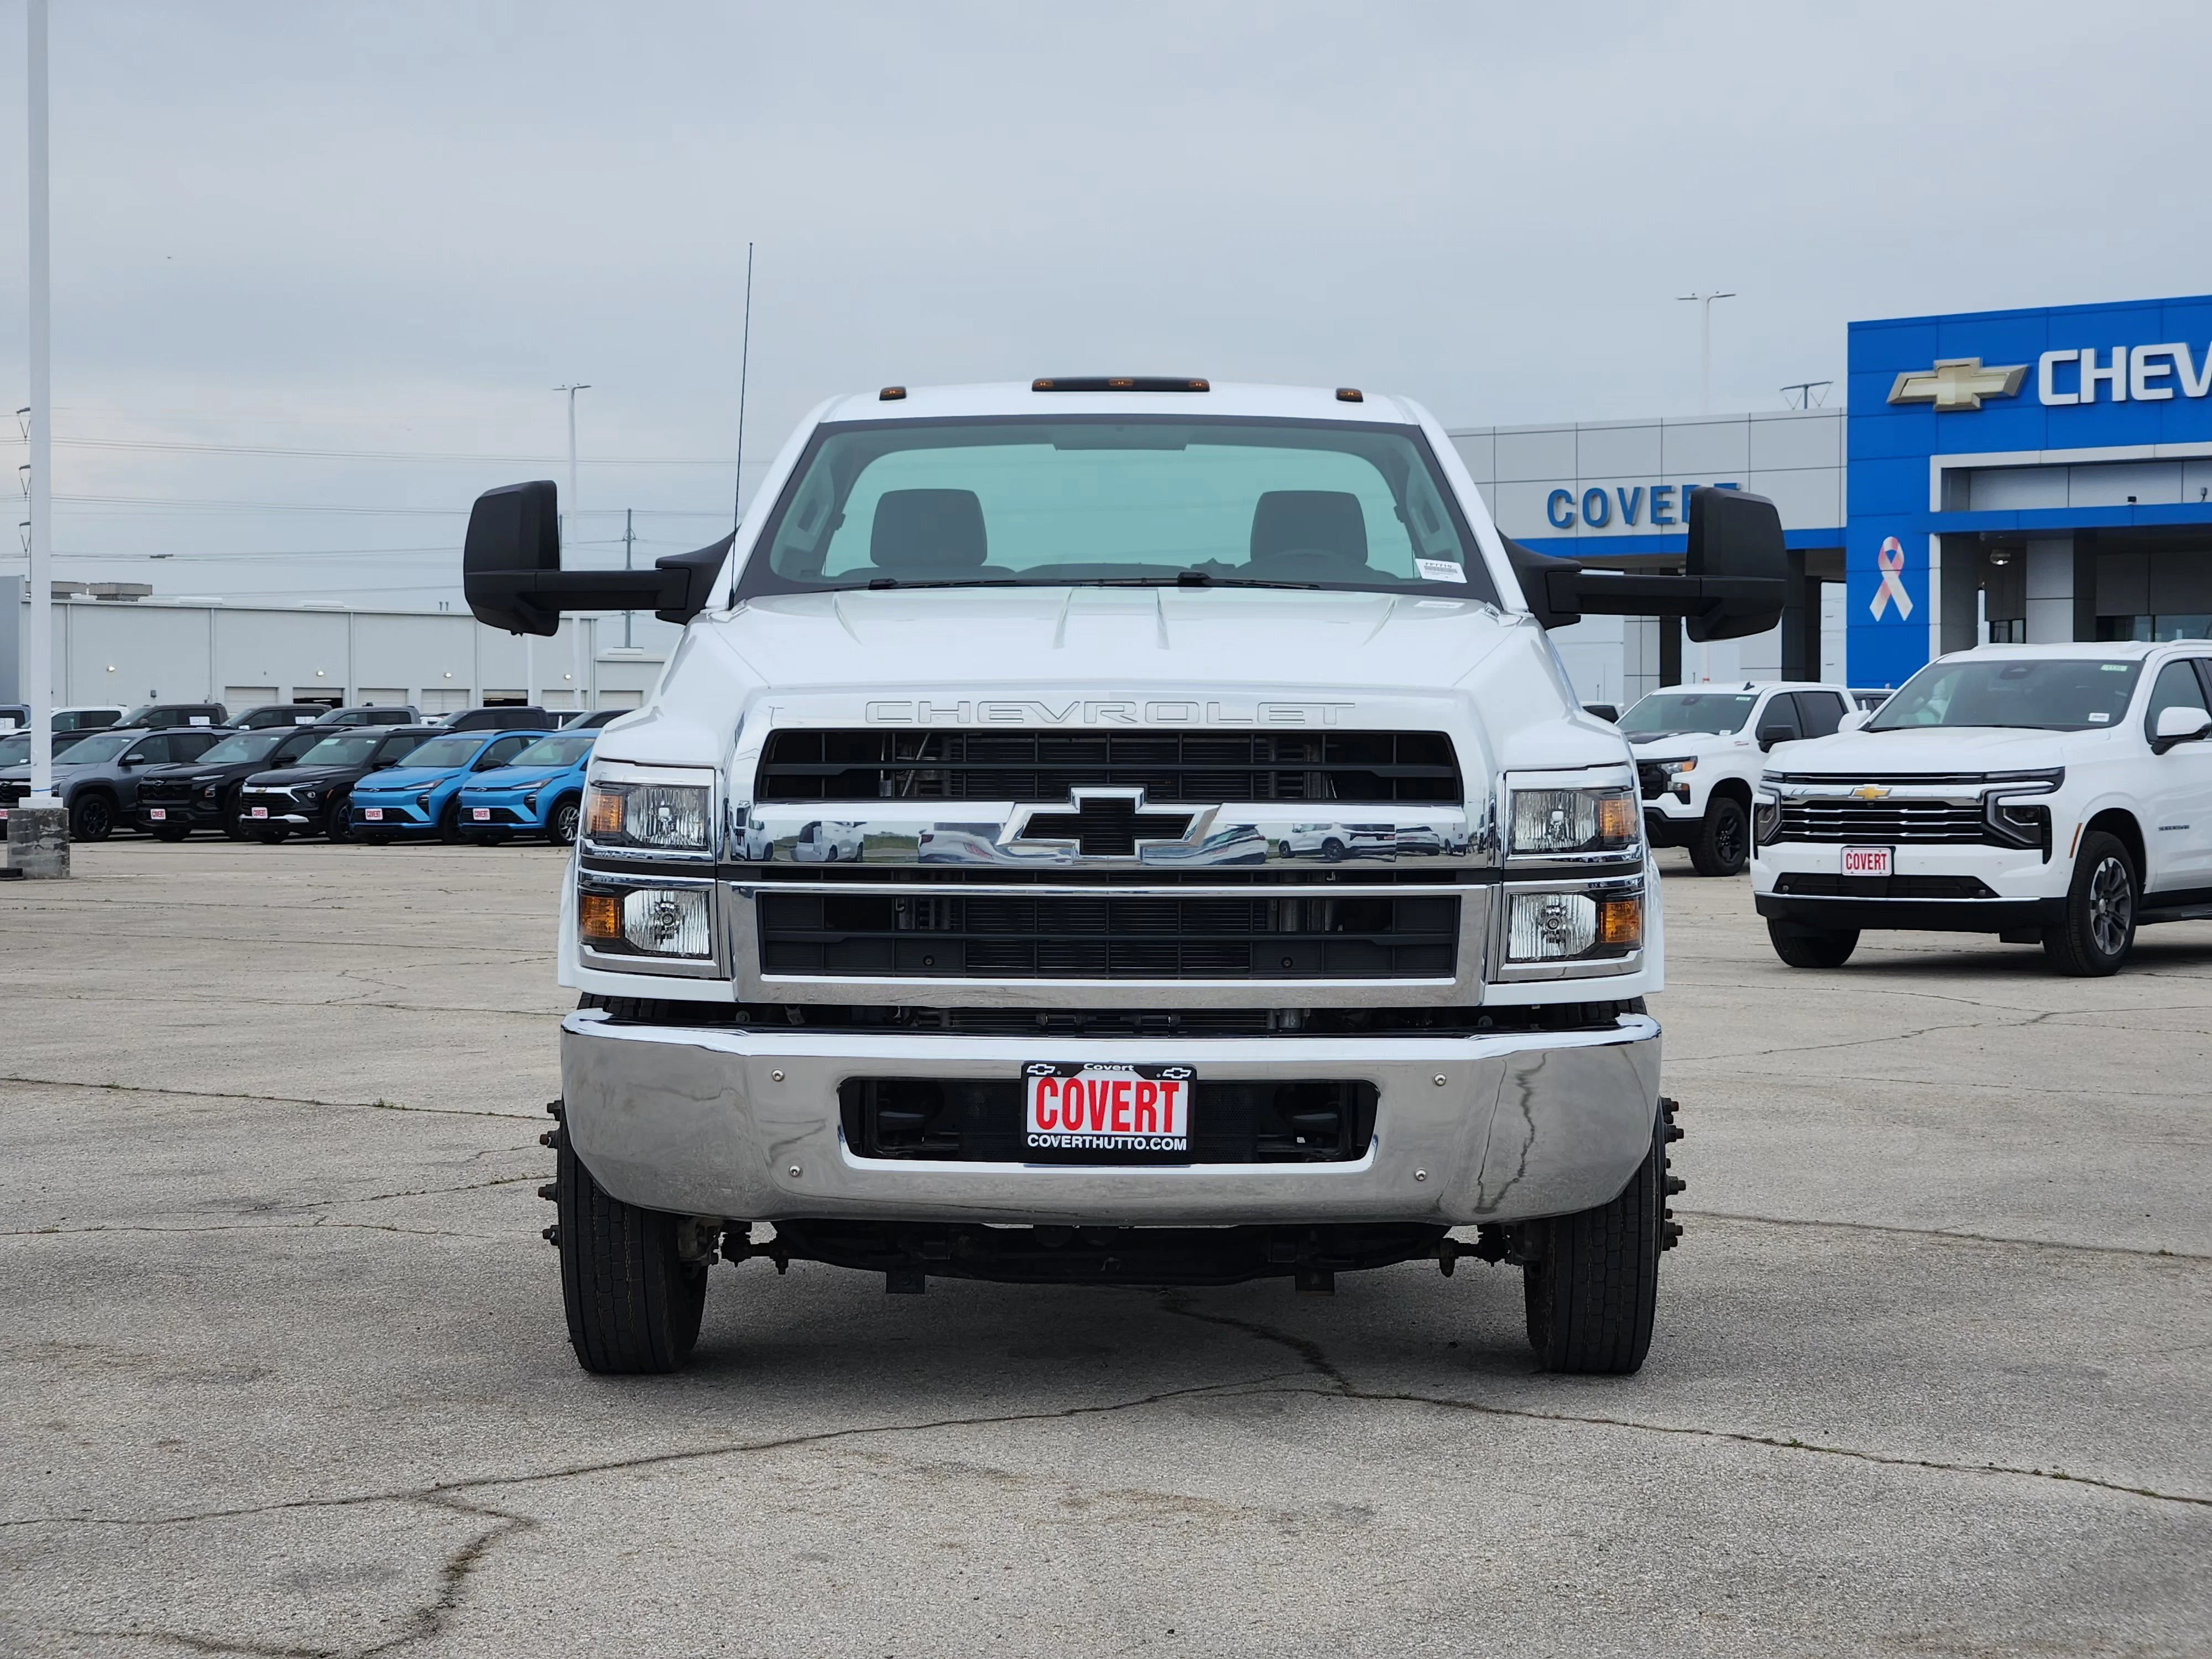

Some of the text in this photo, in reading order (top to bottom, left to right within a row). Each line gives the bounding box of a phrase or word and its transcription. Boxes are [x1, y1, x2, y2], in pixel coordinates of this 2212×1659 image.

[2038, 341, 2212, 405] CHEV
[1547, 482, 1741, 529] COVE
[865, 701, 1355, 725] CHEVROLET
[1846, 853, 1887, 870] COVERT
[1083, 1062, 1135, 1072] Covert
[1036, 1077, 1179, 1134] COVERT
[1027, 1134, 1187, 1151] COVERTHUTTO.COM
